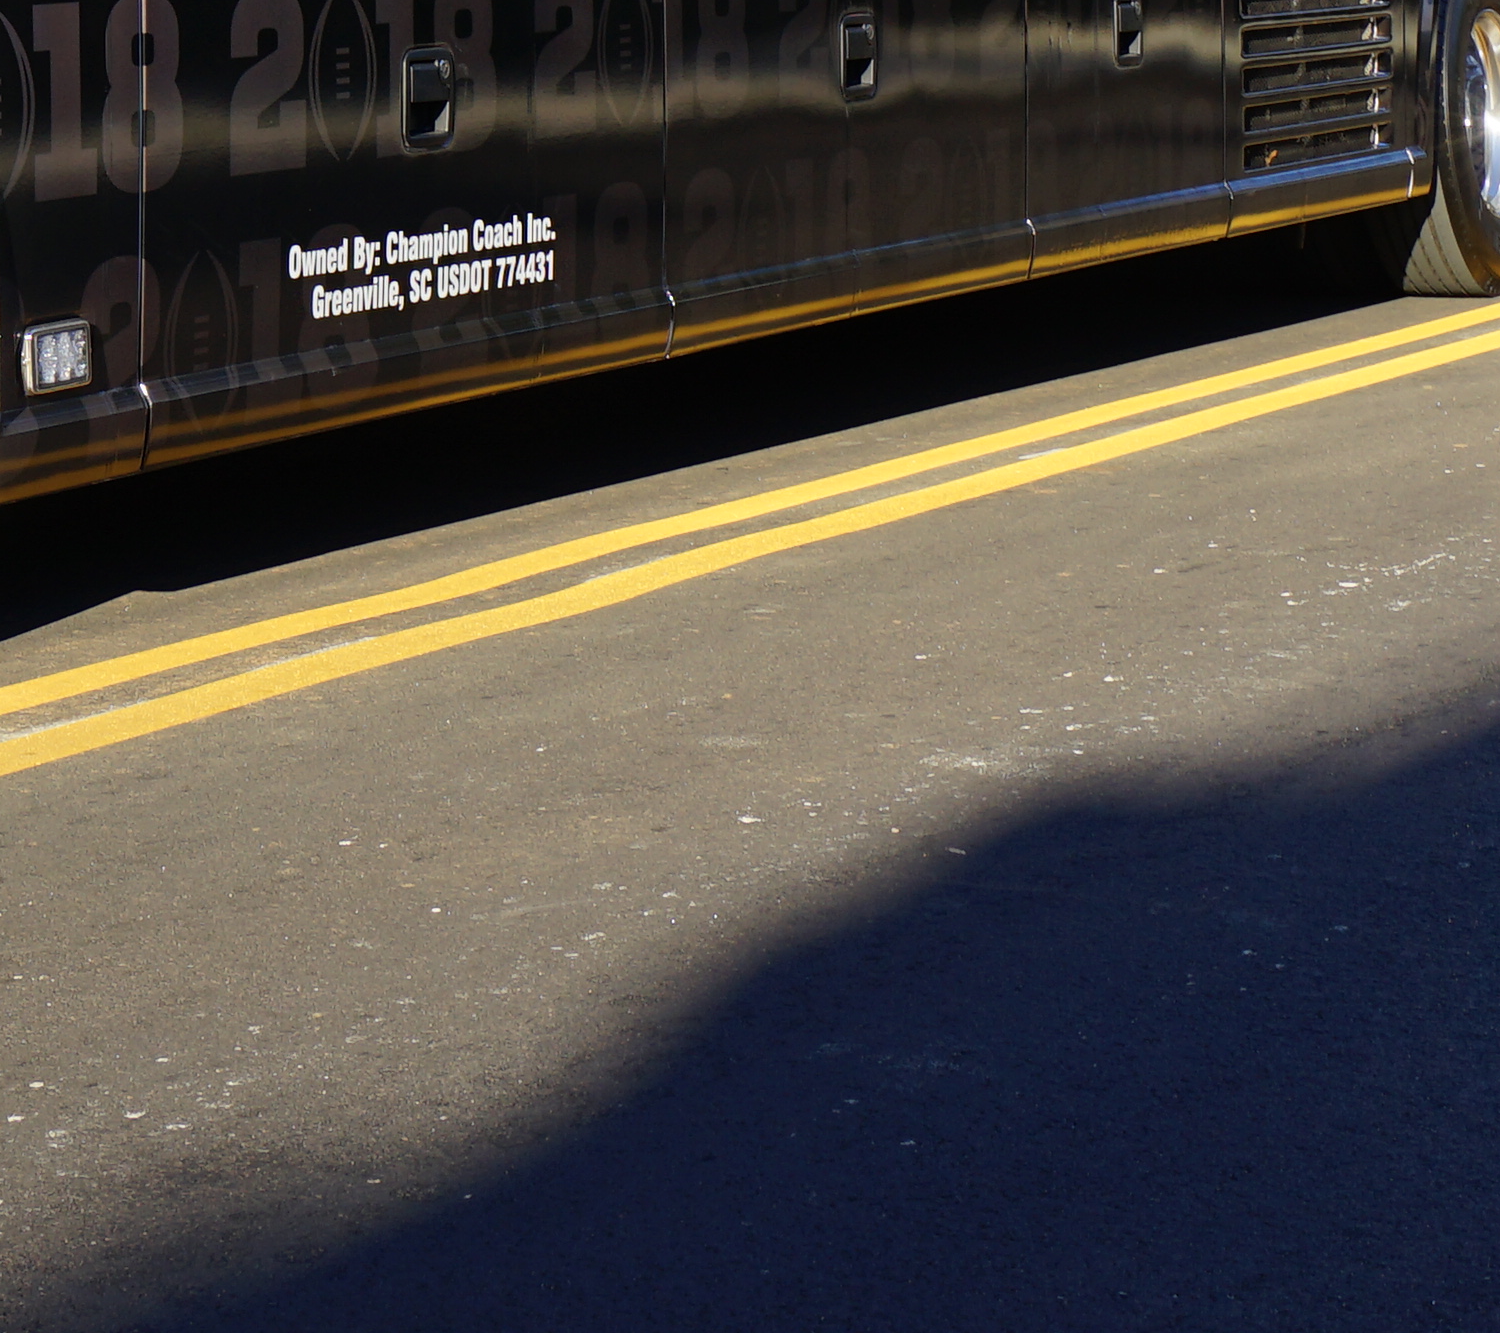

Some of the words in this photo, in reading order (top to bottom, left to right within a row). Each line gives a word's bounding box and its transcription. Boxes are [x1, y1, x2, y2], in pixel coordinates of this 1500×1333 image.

[288, 238, 349, 279] Owned
[353, 235, 381, 275] By:
[385, 223, 468, 265] Champion
[472, 214, 523, 252] Coach
[526, 212, 556, 244] Inc.
[312, 275, 405, 319] Greenville,
[409, 268, 433, 304] SC
[437, 259, 493, 299] USDOT
[496, 250, 554, 289] 774431
